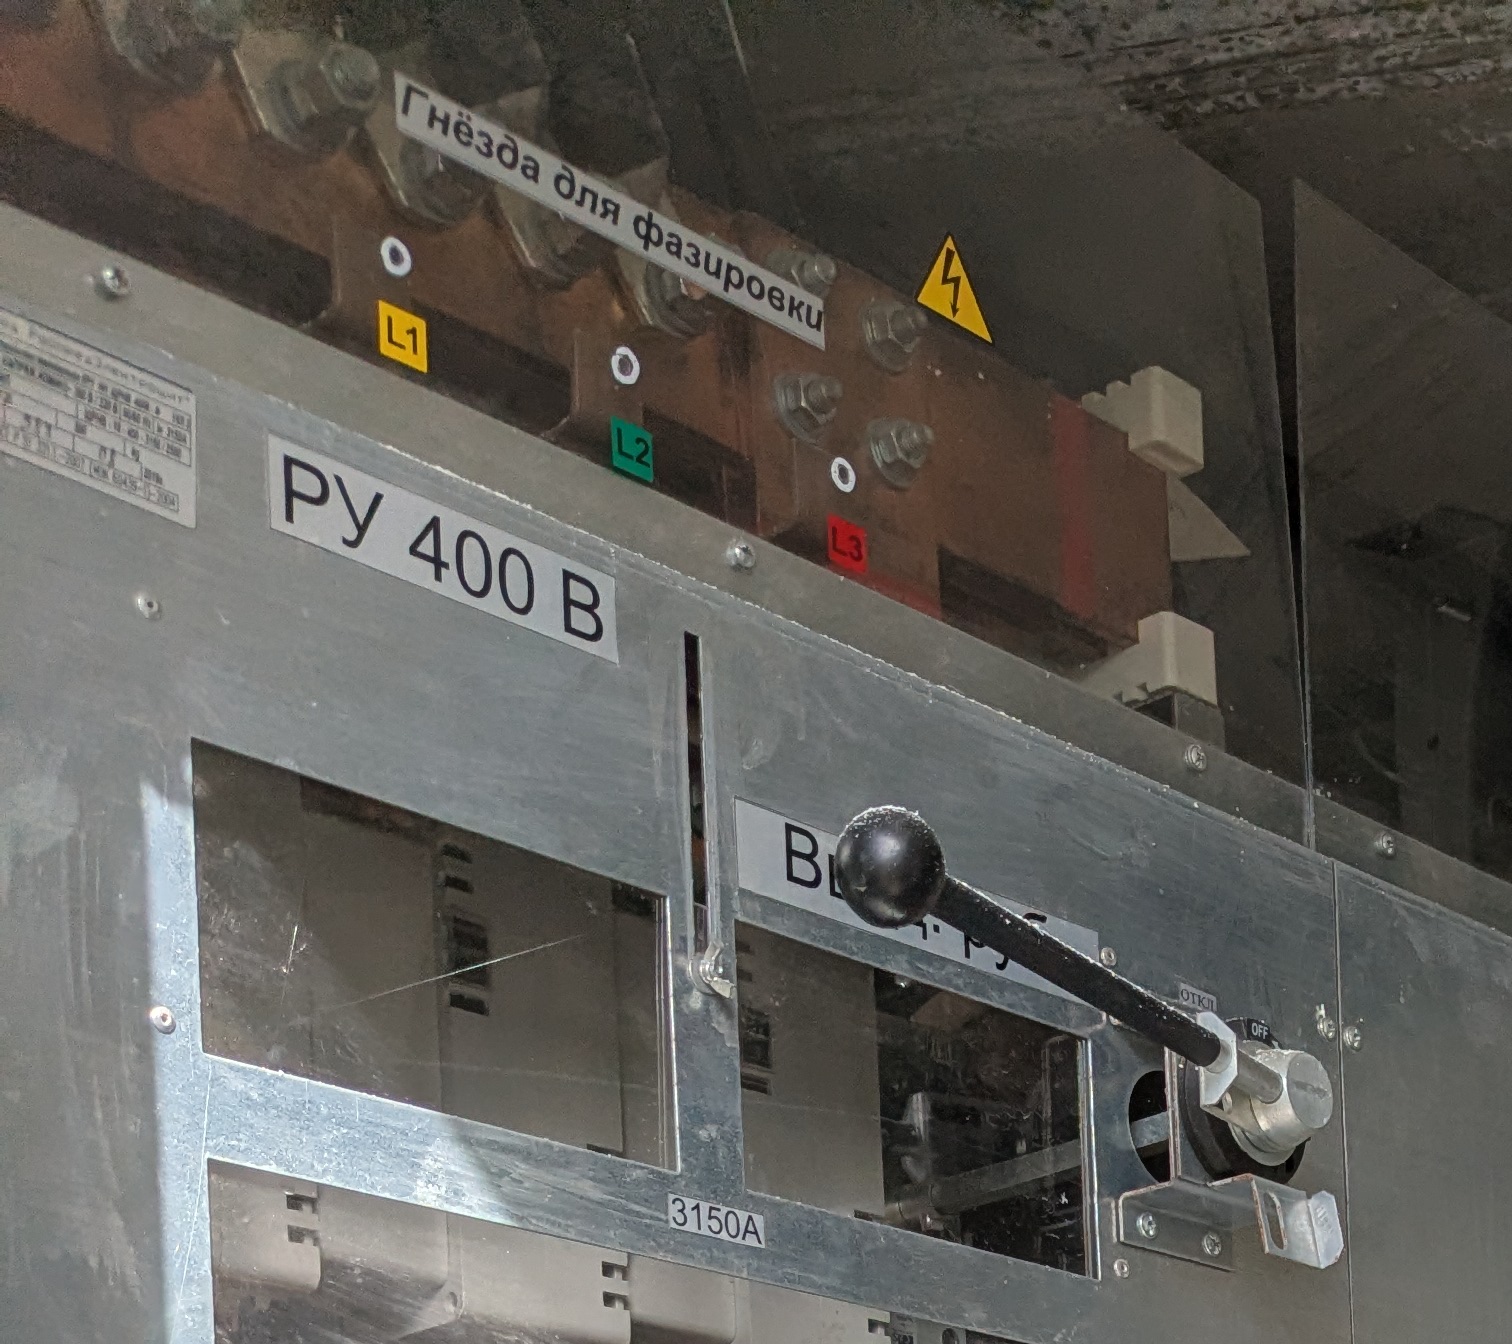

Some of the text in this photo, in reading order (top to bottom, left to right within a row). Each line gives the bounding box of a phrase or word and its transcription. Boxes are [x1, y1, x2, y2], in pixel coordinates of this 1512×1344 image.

[401, 84, 825, 333] Гнёзда для фазировки
[386, 315, 419, 356] L1
[615, 428, 651, 469] L2
[283, 453, 604, 643] РУ 400 В
[831, 526, 863, 562] L3
[1251, 1022, 1269, 1040] OFF
